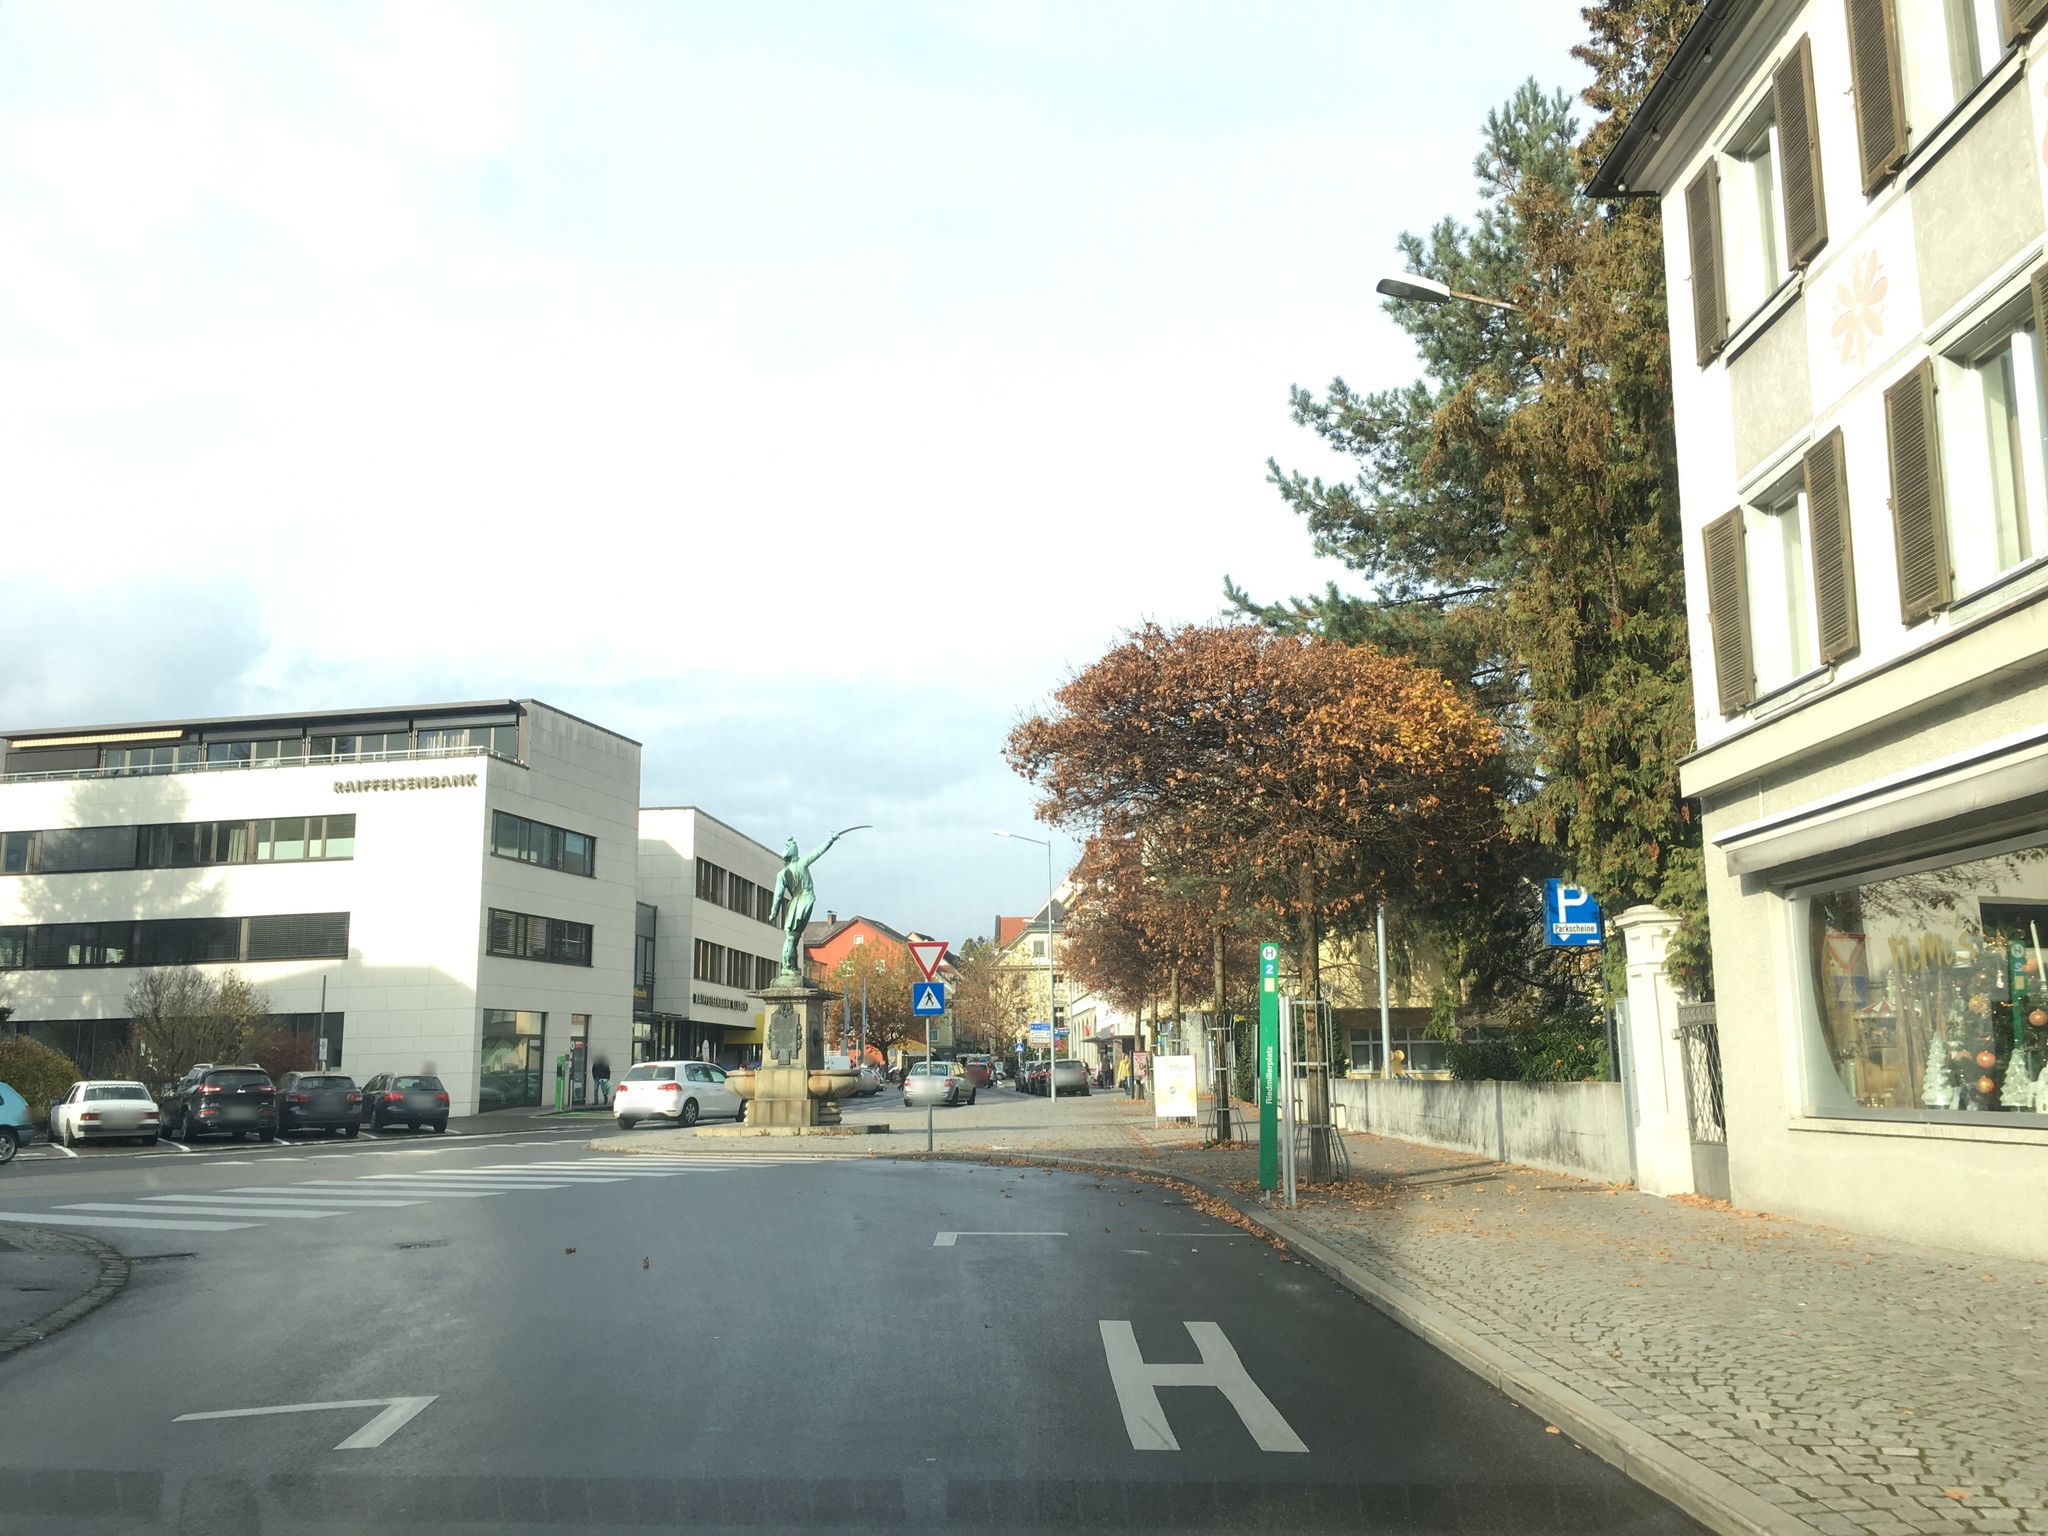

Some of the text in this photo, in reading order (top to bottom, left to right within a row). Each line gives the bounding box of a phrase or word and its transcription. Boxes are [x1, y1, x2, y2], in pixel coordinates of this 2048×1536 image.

[333, 774, 478, 794] RAIFFEISENBANK
[1557, 884, 1588, 923] P
[1555, 924, 1595, 933] Parkscheine
[1265, 948, 1274, 958] H
[1265, 964, 1274, 975] 2
[1265, 1045, 1273, 1105] Riedmillerplatz
[1099, 1320, 1310, 1452] H
